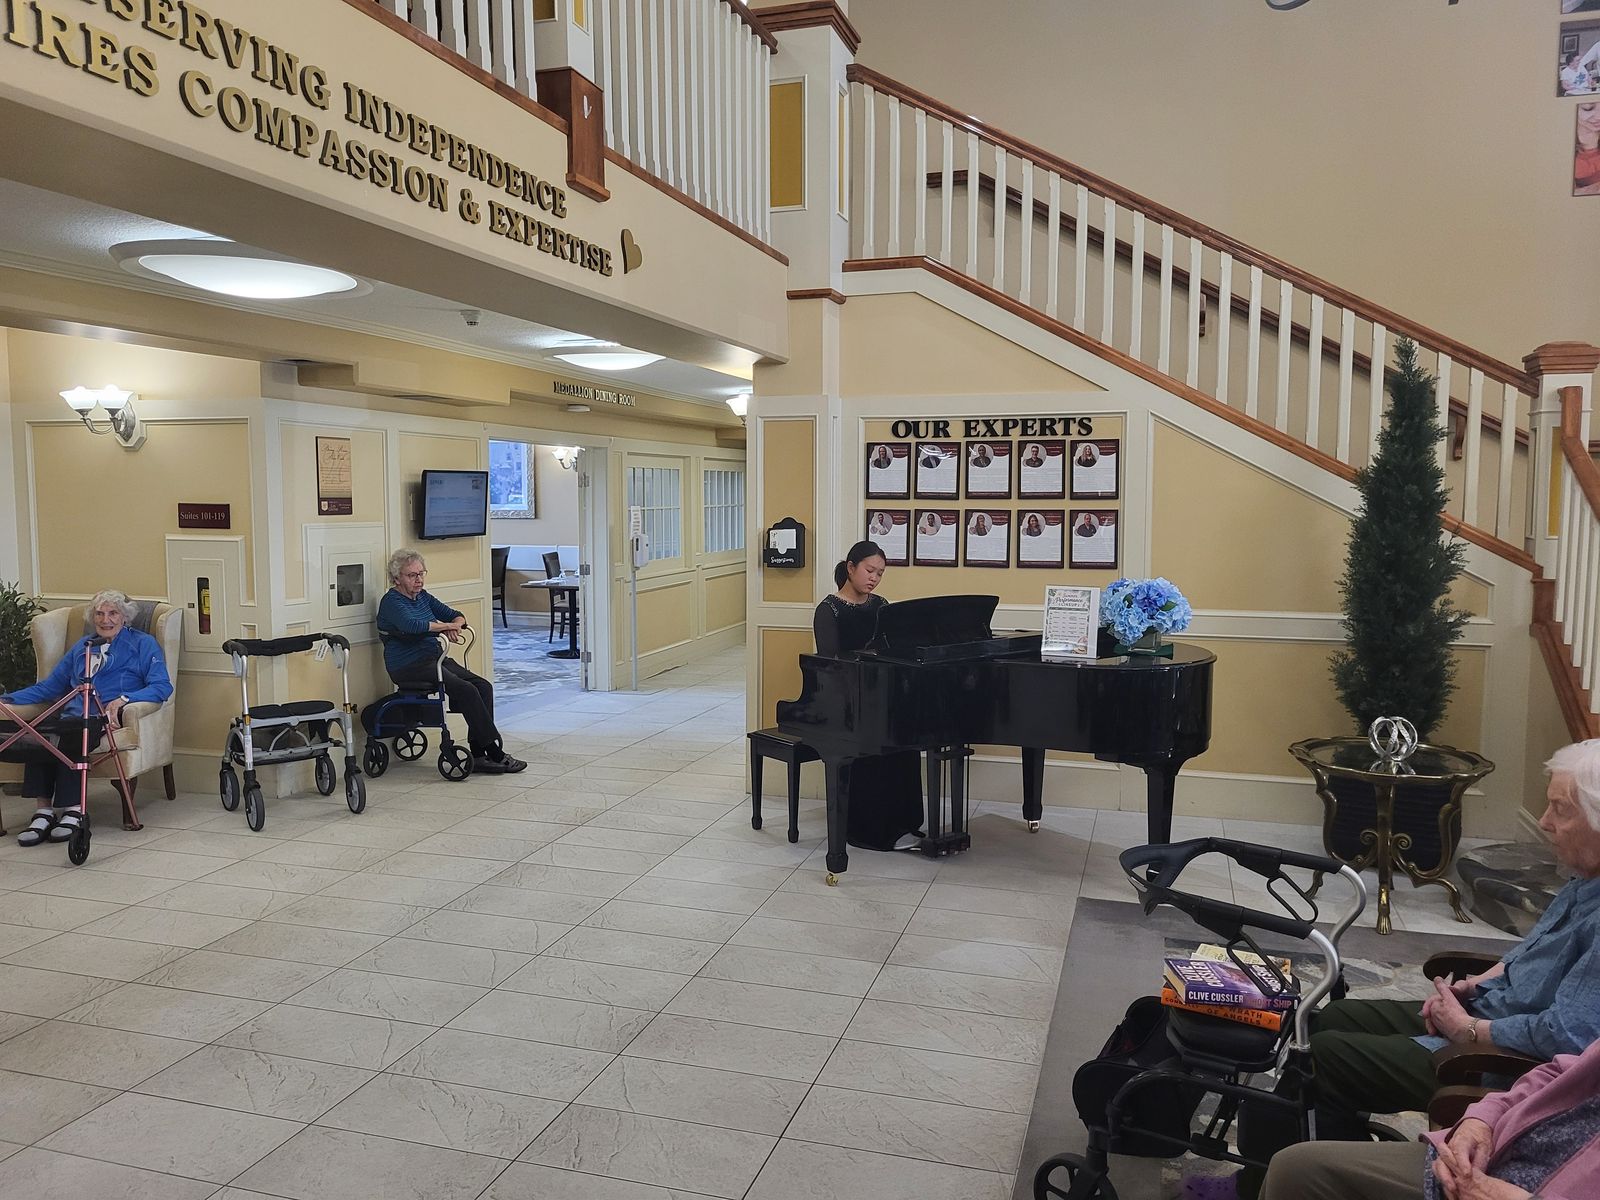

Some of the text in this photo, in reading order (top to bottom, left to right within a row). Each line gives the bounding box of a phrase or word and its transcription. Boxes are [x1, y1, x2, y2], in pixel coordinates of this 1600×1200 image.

[342, 81, 567, 219] INDEPENDENCE
[178, 69, 449, 212] COMPASSION
[458, 188, 482, 224] &
[488, 200, 613, 277] EXPERTISE
[553, 381, 636, 407] MEDALLION DINING ROOM
[891, 417, 1093, 439] OUR EXPERTS
[1188, 991, 1210, 1001] CLIVE
[1210, 993, 1244, 1003] CUSSLER
[1274, 999, 1292, 1009] SHIP
